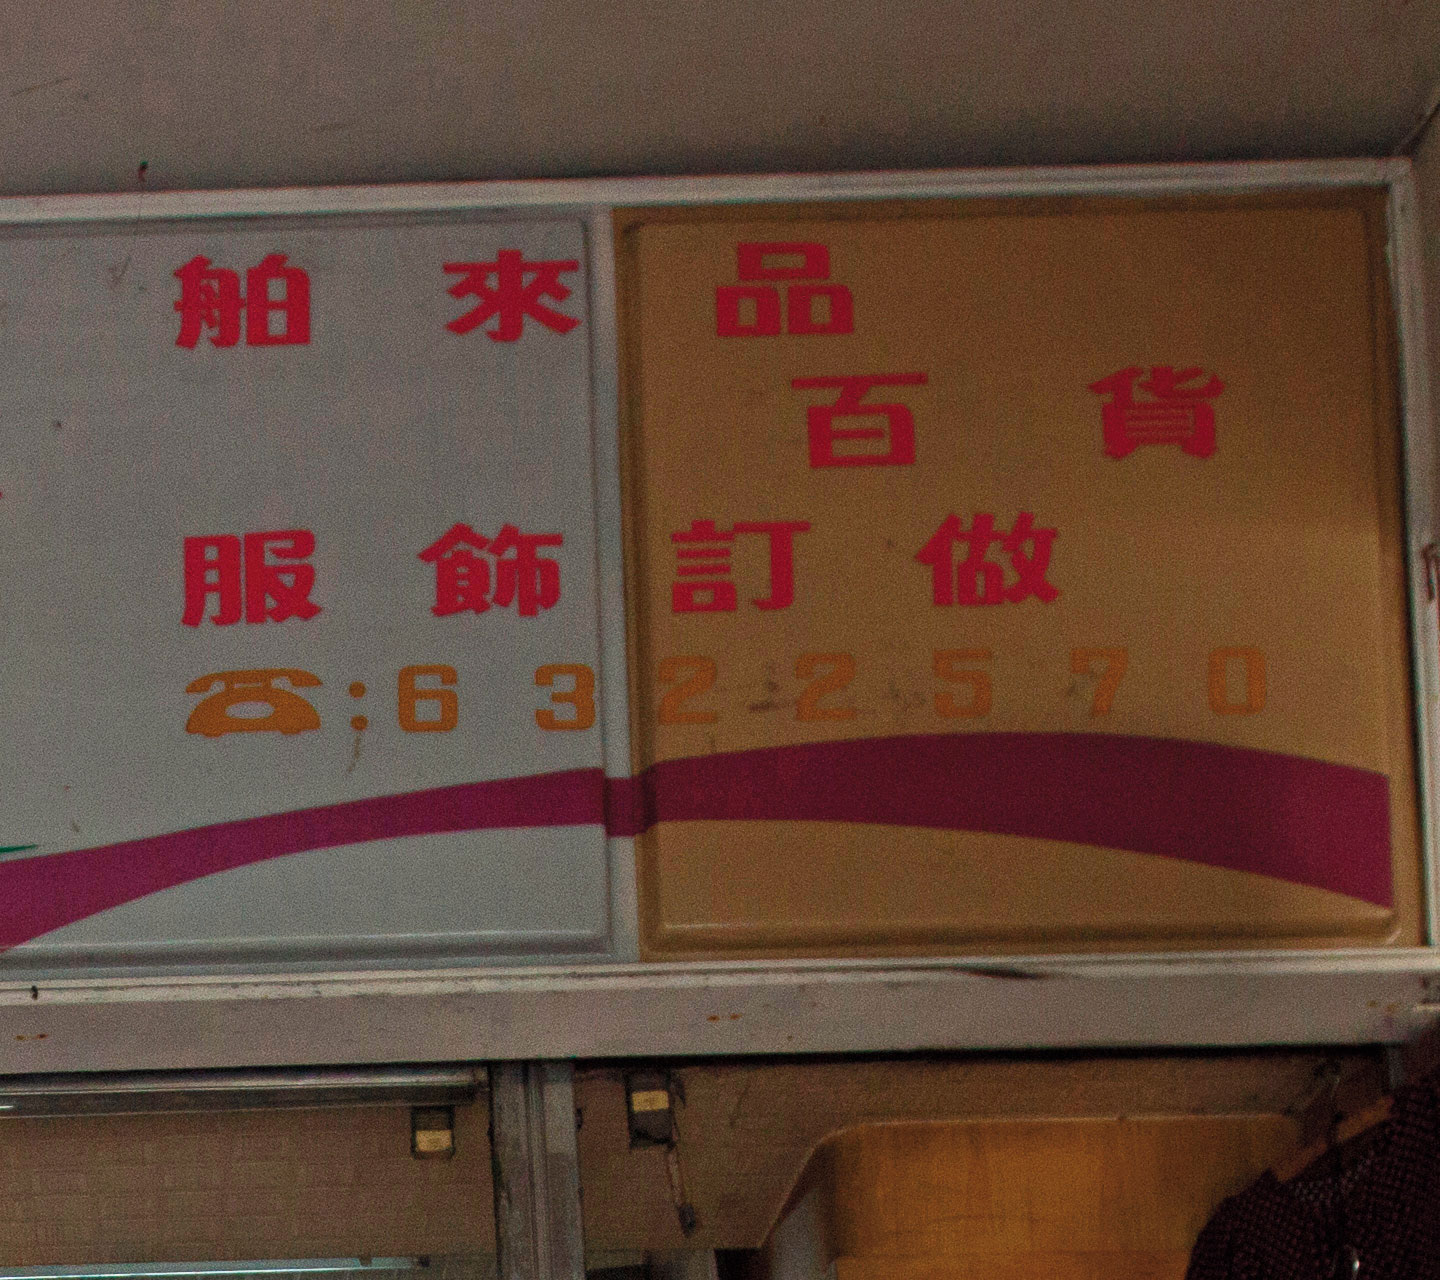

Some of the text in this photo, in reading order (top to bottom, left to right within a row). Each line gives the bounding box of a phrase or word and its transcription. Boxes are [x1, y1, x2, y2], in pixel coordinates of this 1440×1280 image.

[174, 242, 856, 348] 舶來品
[793, 365, 1225, 468] 百貨
[181, 512, 1061, 627] 服飾訂做
